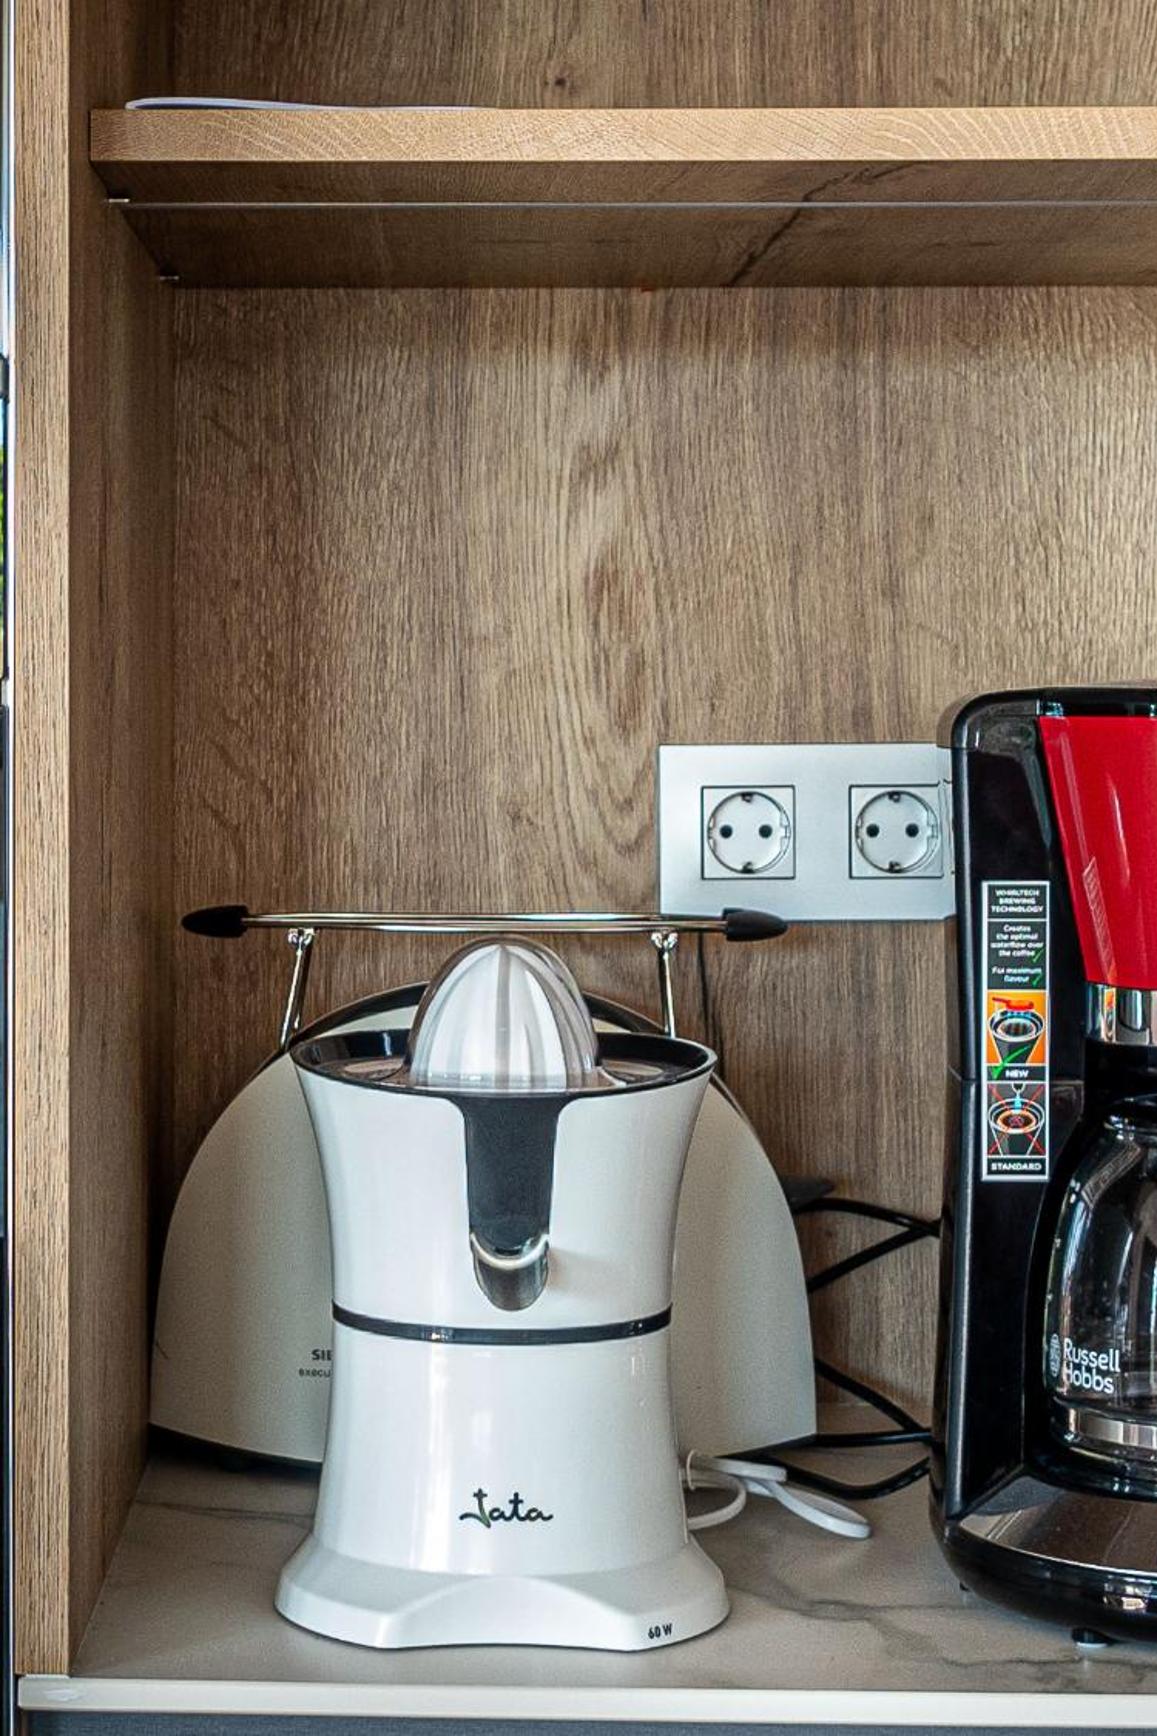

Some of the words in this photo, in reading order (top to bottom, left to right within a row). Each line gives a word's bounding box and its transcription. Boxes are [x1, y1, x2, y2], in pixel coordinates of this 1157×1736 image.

[998, 897, 1036, 905] BREWING
[991, 905, 1044, 913] TECHNOLOGY
[996, 933, 1009, 941] the
[1010, 933, 1039, 942] optimal
[998, 949, 1011, 957] the
[1006, 967, 1043, 975] maximum
[1005, 1070, 1030, 1079] NEW
[991, 1162, 1042, 1172] STANDARD
[1063, 1337, 1121, 1373] Russell
[1062, 1360, 1115, 1395] Hobbs
[459, 1488, 553, 1529] Jata
[647, 1625, 661, 1640] 60
[662, 1622, 673, 1637] W
